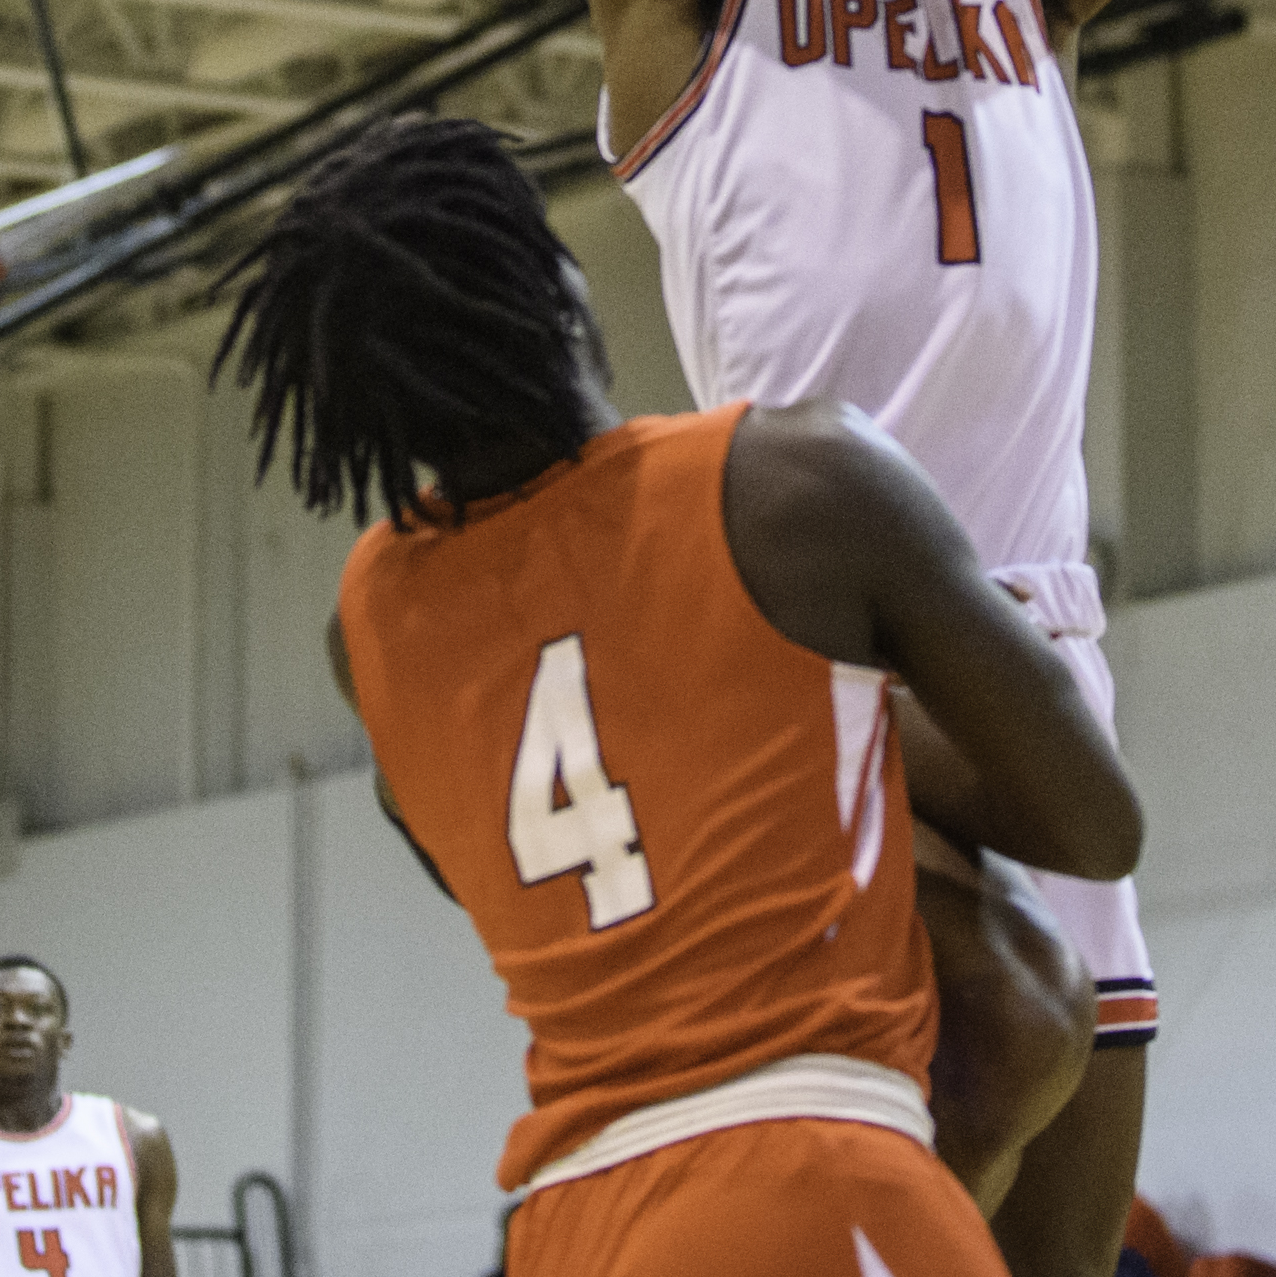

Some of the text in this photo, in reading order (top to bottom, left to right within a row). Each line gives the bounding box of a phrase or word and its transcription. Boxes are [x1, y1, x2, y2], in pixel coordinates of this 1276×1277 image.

[922, 108, 981, 265] 1
[507, 632, 656, 932] 4
[15, 1227, 70, 1277] 4
